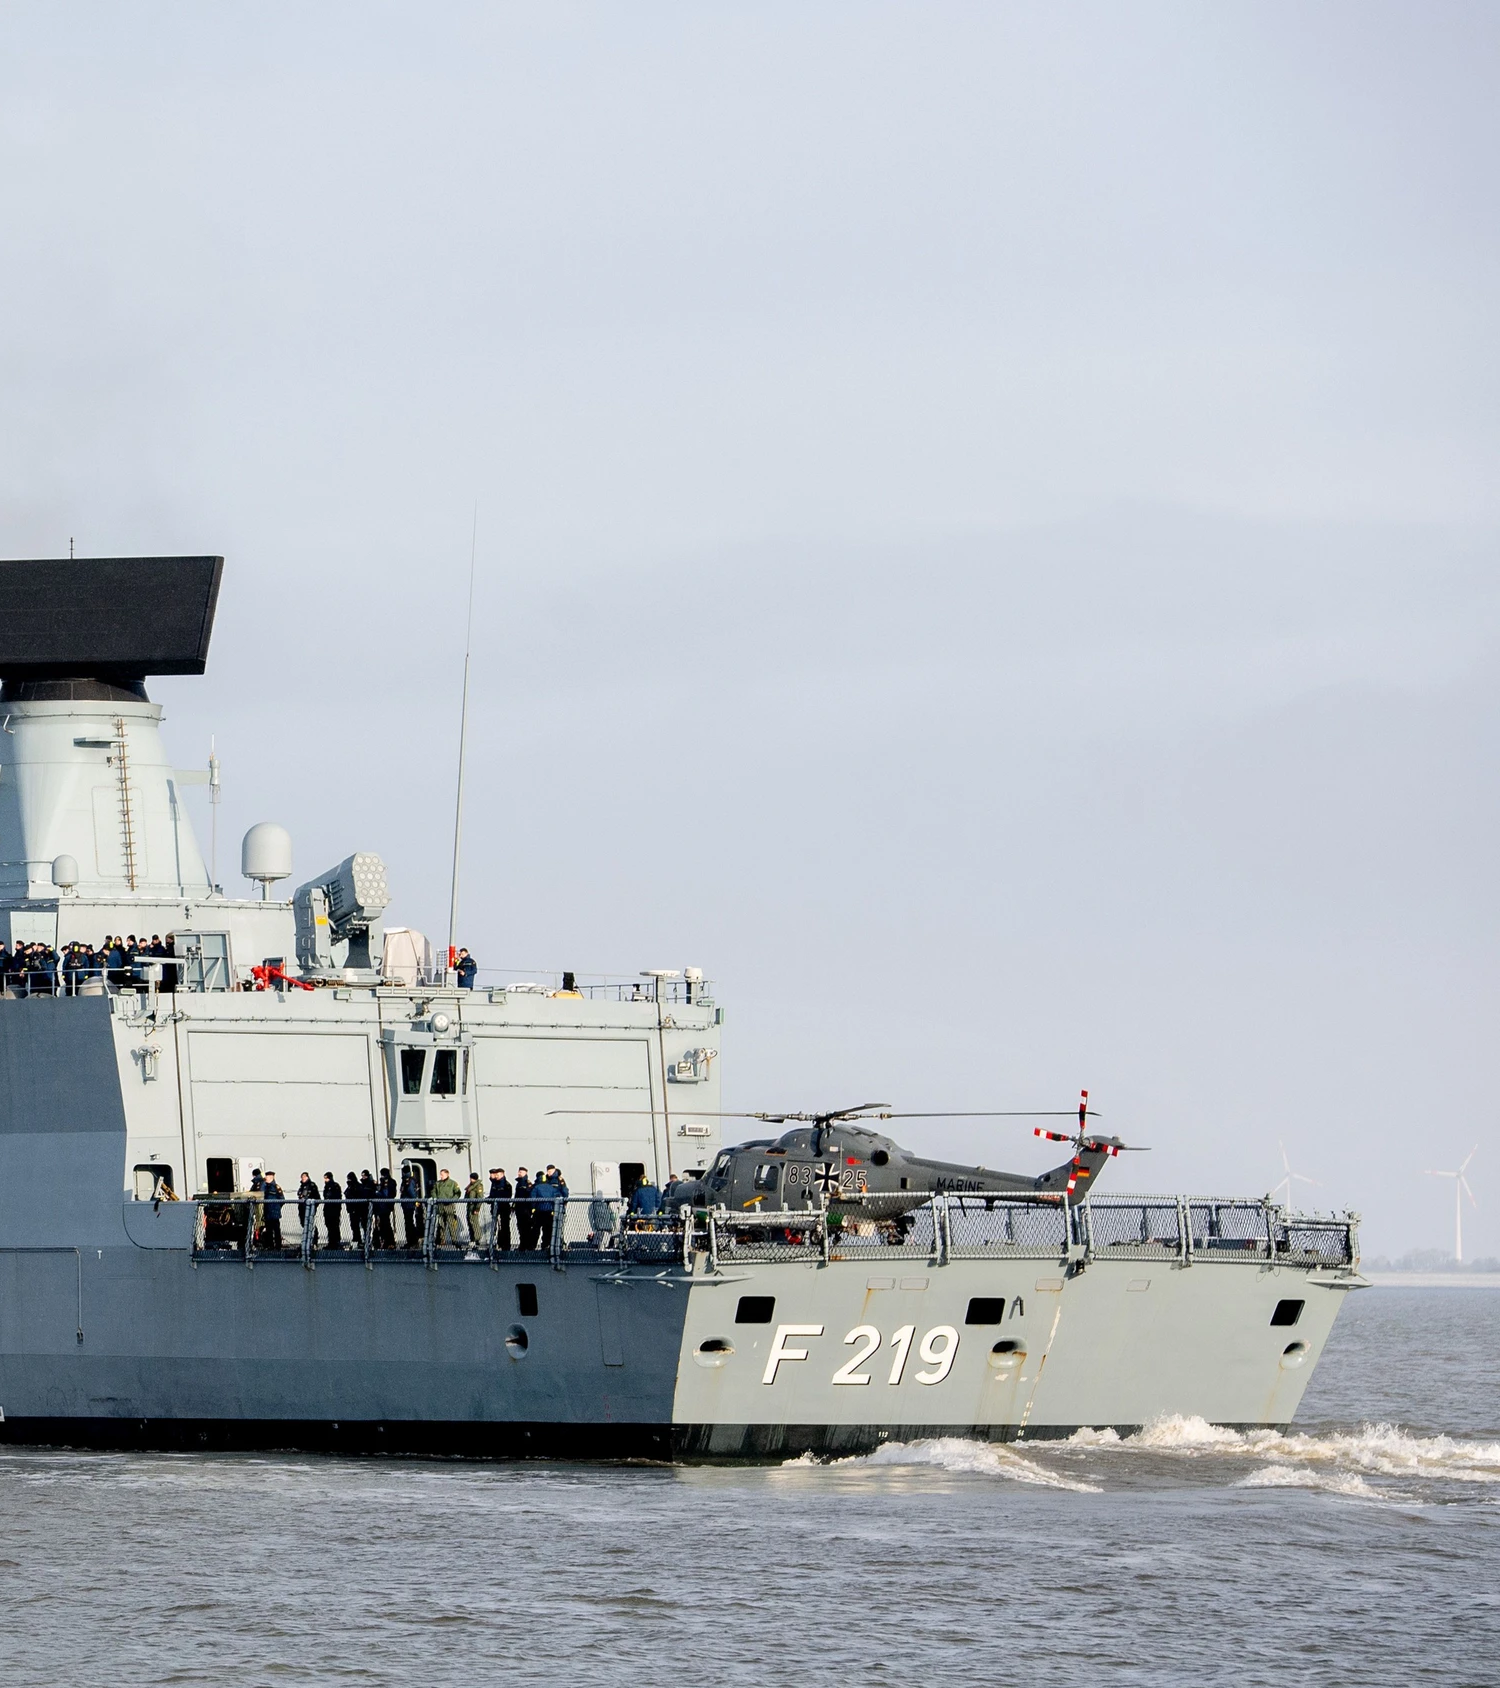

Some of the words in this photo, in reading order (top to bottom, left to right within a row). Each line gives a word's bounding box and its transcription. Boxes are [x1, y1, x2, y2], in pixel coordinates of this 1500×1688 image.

[788, 1165, 812, 1185] 83
[842, 1169, 867, 1190] 25
[936, 1177, 985, 1191] MARINE
[762, 1324, 824, 1385] F
[831, 1324, 961, 1386] 219
